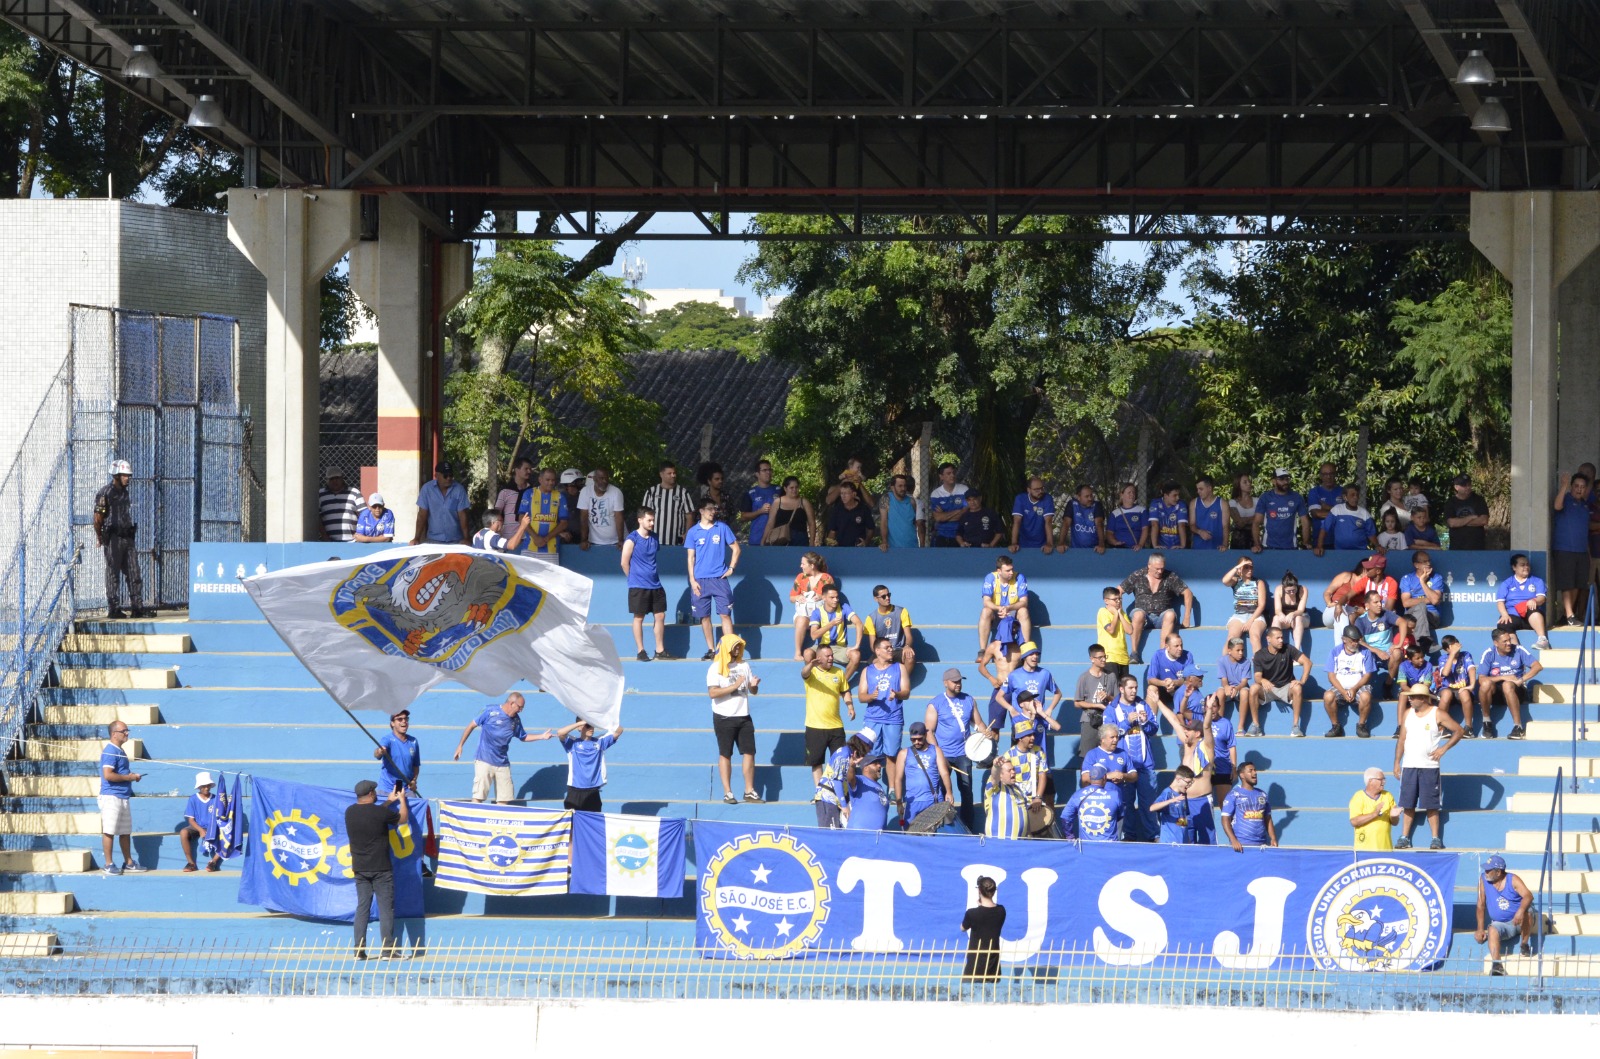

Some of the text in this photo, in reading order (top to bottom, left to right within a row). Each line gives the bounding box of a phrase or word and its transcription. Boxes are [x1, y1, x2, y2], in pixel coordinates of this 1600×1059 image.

[193, 583, 247, 593] PREFEREN
[720, 890, 811, 911] SÃO JOSÉ E.C.
[1318, 865, 1413, 912] UNIFORMIZADA
[1415, 878, 1431, 896] DO
[1428, 898, 1441, 928] SÃO
